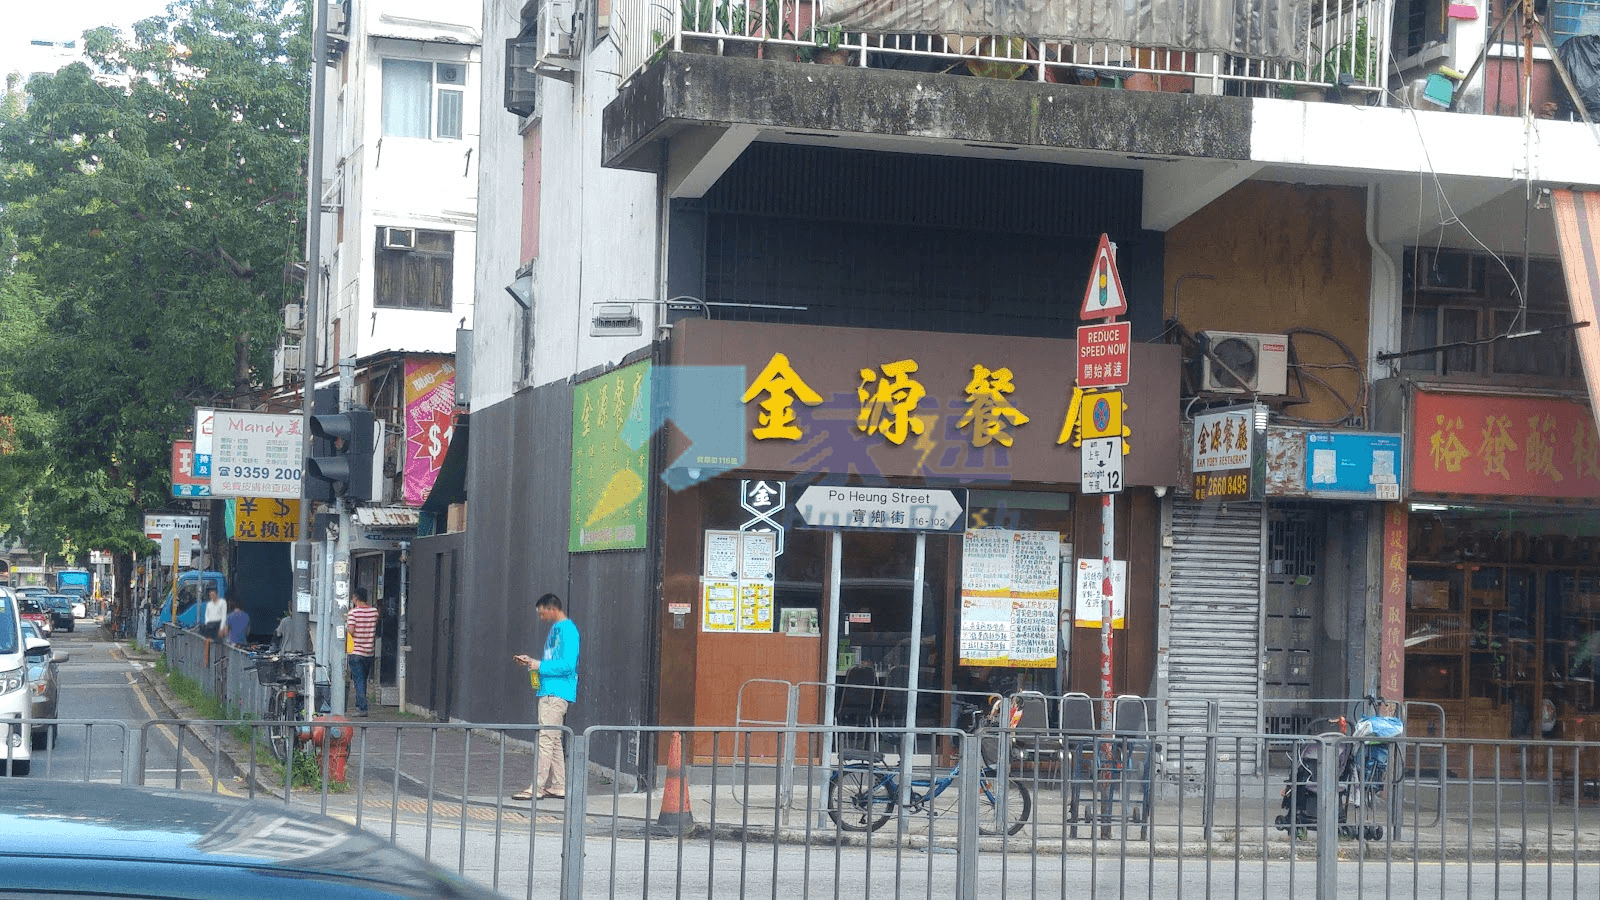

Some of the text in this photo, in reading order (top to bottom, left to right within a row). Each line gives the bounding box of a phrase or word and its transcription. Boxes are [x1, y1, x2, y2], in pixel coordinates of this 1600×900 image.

[1088, 330, 1119, 343] REDUCE
[1081, 343, 1127, 358] SPEED NOW
[1084, 361, 1122, 379] 開始減速
[228, 417, 284, 438] Mandy
[1198, 416, 1248, 455] 金源餐廳
[1088, 450, 1100, 461] 上午
[1106, 441, 1113, 459] 7
[1219, 454, 1248, 466] RESTAURANT
[234, 466, 301, 481] 9359 200
[1083, 470, 1120, 489] midnight 12
[749, 480, 777, 507] 金
[1208, 474, 1248, 497] 2660 8495
[829, 490, 931, 505] Po Heung Street
[852, 509, 905, 525] 寶鄉街
[910, 517, 946, 527] 116-102
[1386, 610, 1401, 692] 取價公道
